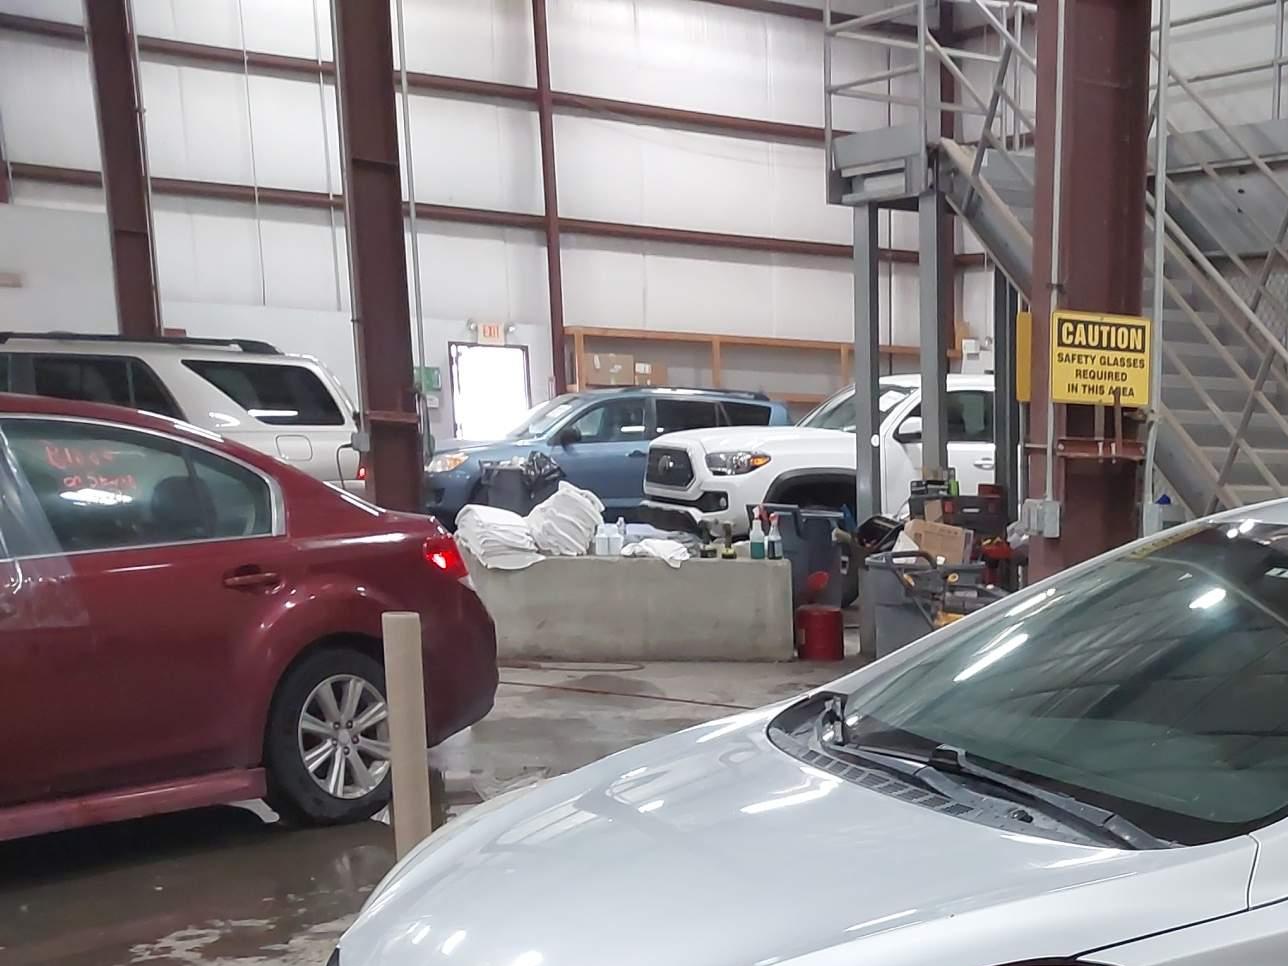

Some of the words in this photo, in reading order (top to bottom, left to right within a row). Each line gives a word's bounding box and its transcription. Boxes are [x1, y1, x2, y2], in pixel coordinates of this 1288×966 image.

[1061, 322, 1142, 350] CAUTION
[1057, 352, 1096, 365] SAFETY
[1100, 356, 1145, 368] GLASSES
[1075, 369, 1128, 382] REQUIRED
[1067, 383, 1078, 393] IN
[1081, 384, 1105, 395] THIS
